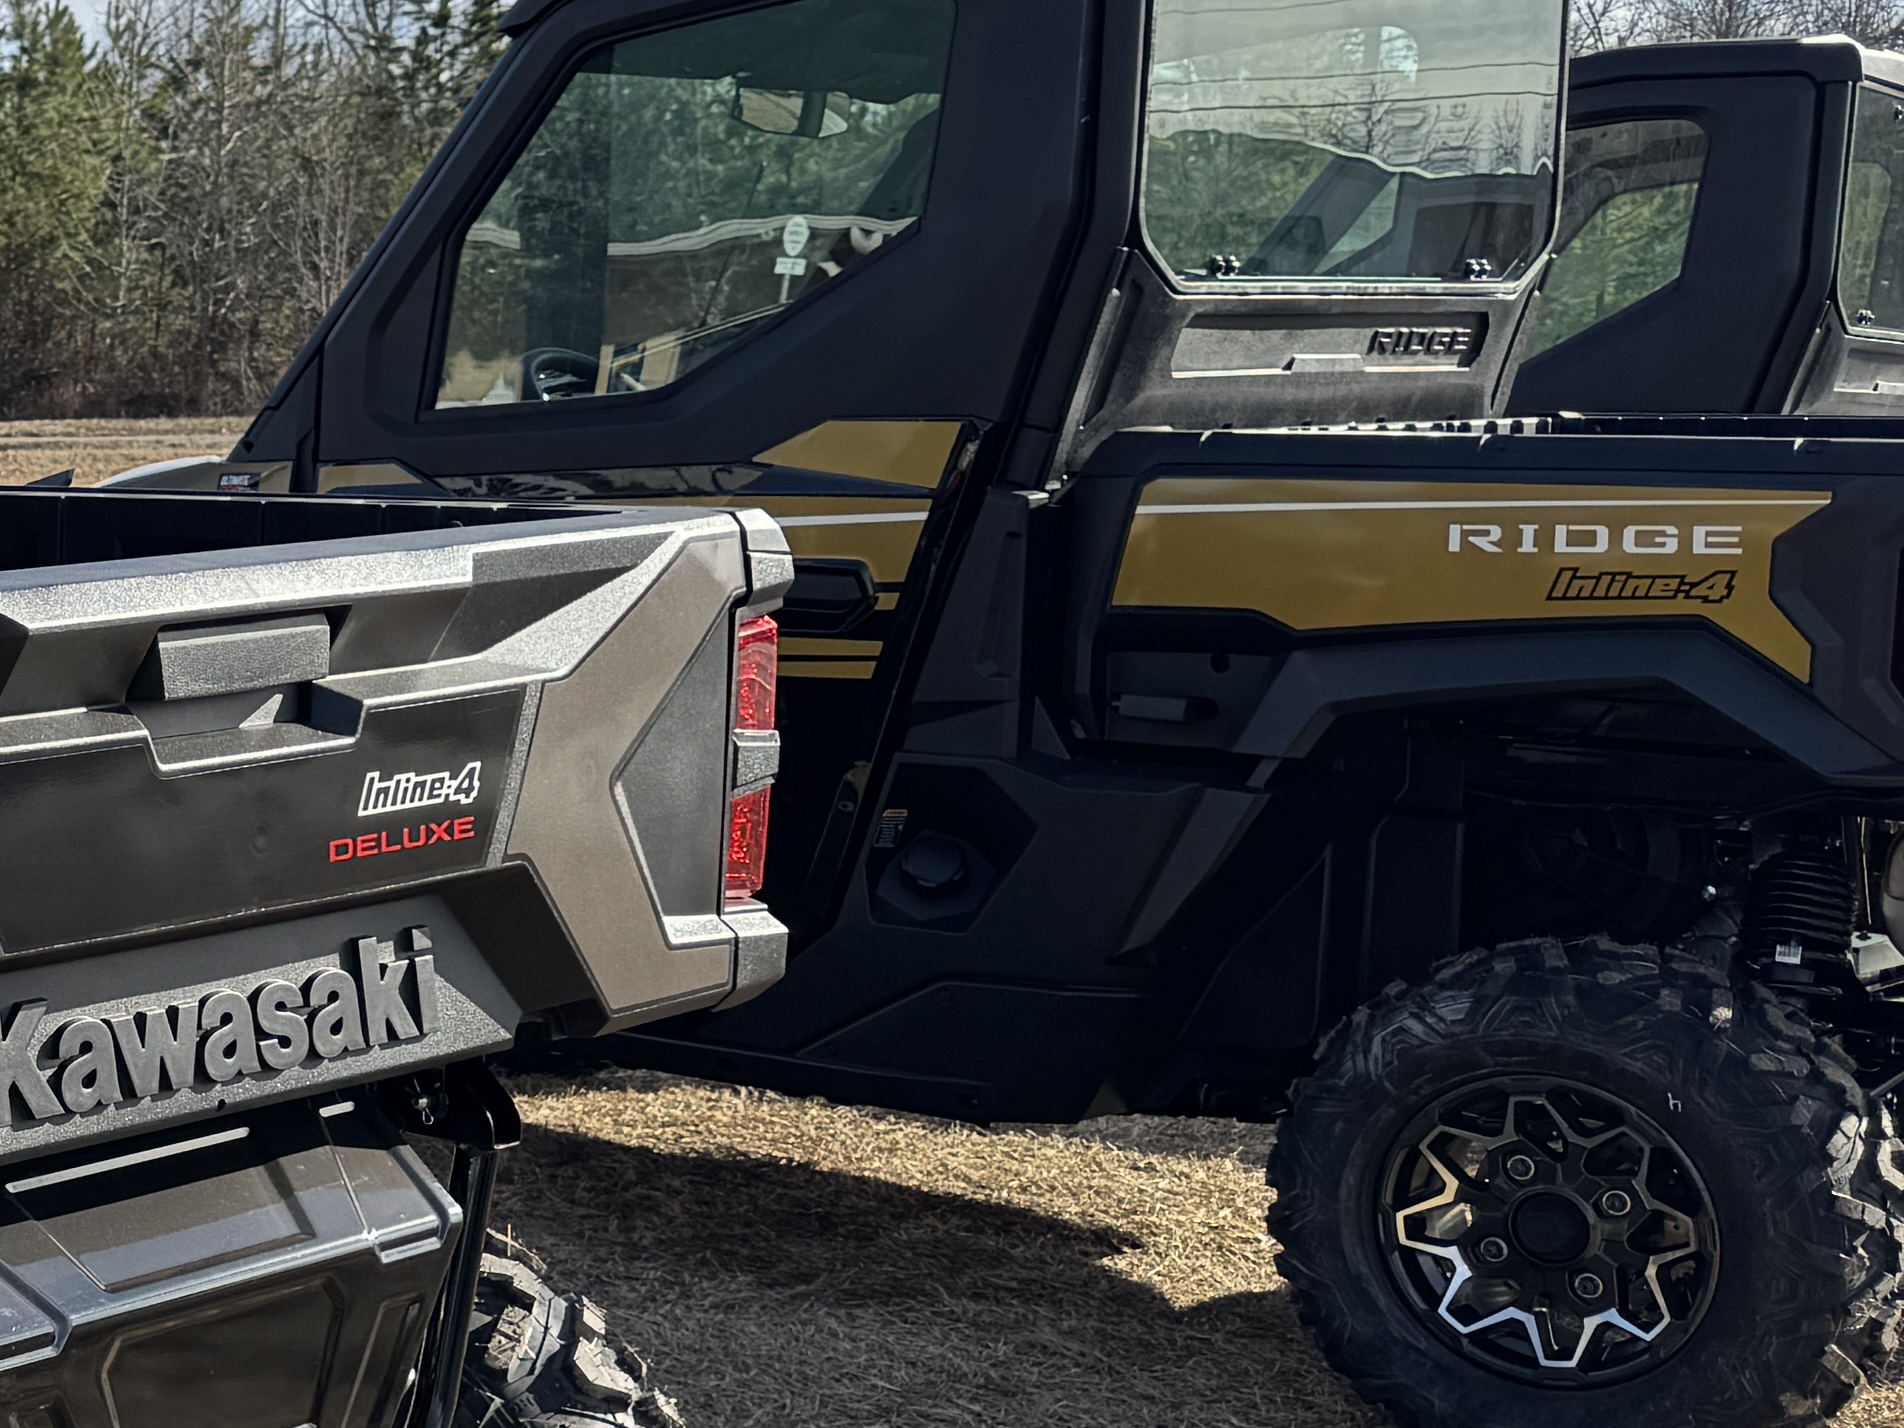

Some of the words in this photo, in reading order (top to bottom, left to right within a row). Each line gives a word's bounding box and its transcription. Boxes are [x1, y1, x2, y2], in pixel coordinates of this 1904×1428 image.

[1366, 327, 1472, 356] RIDGE
[1448, 523, 1743, 555] RIDGE
[1544, 566, 1739, 604] Inline-4
[357, 760, 482, 817] Inline-4
[328, 815, 476, 864] DELUXE
